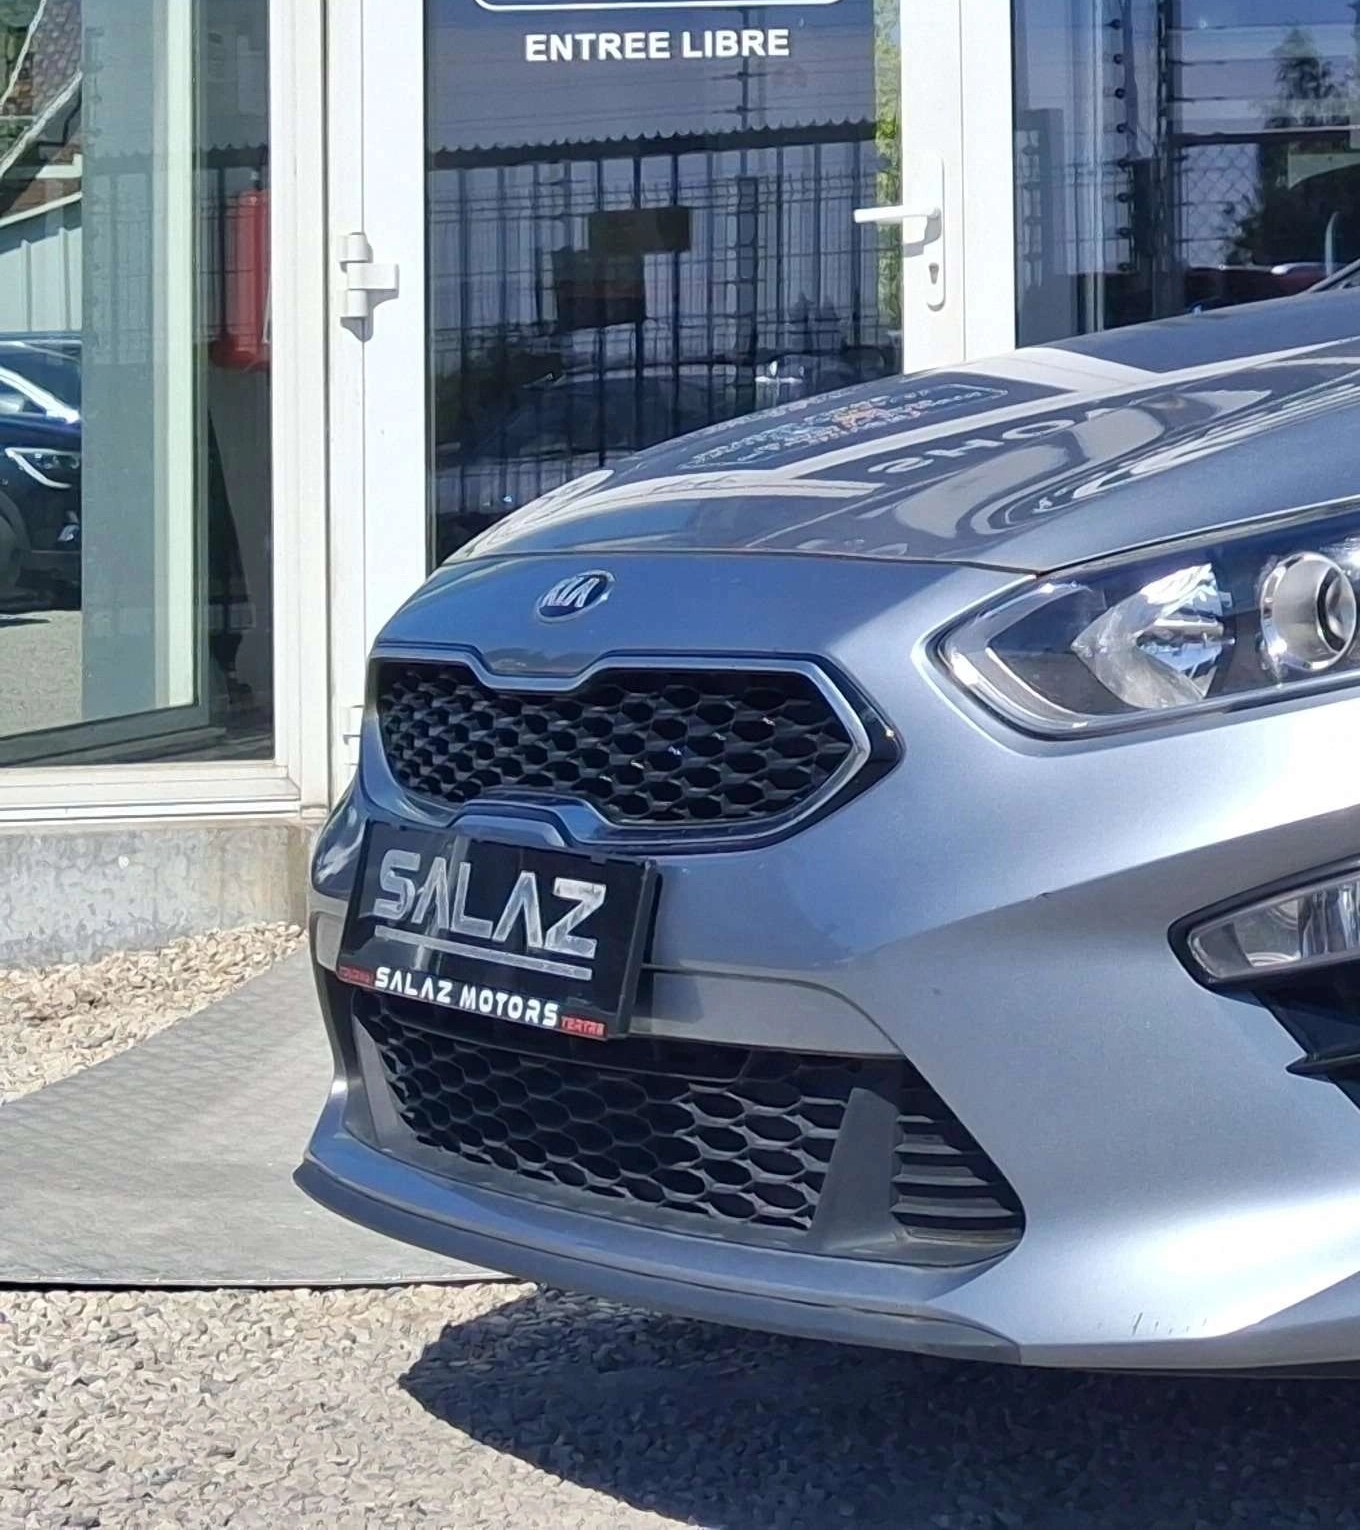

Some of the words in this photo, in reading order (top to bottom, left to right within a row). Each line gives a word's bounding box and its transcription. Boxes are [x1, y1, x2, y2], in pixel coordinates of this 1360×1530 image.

[525, 31, 671, 61] ENTREE
[681, 28, 790, 58] LIBRE
[374, 848, 607, 960] SALAZ
[374, 966, 454, 1004] SALAZ
[459, 983, 560, 1028] MOTORS
